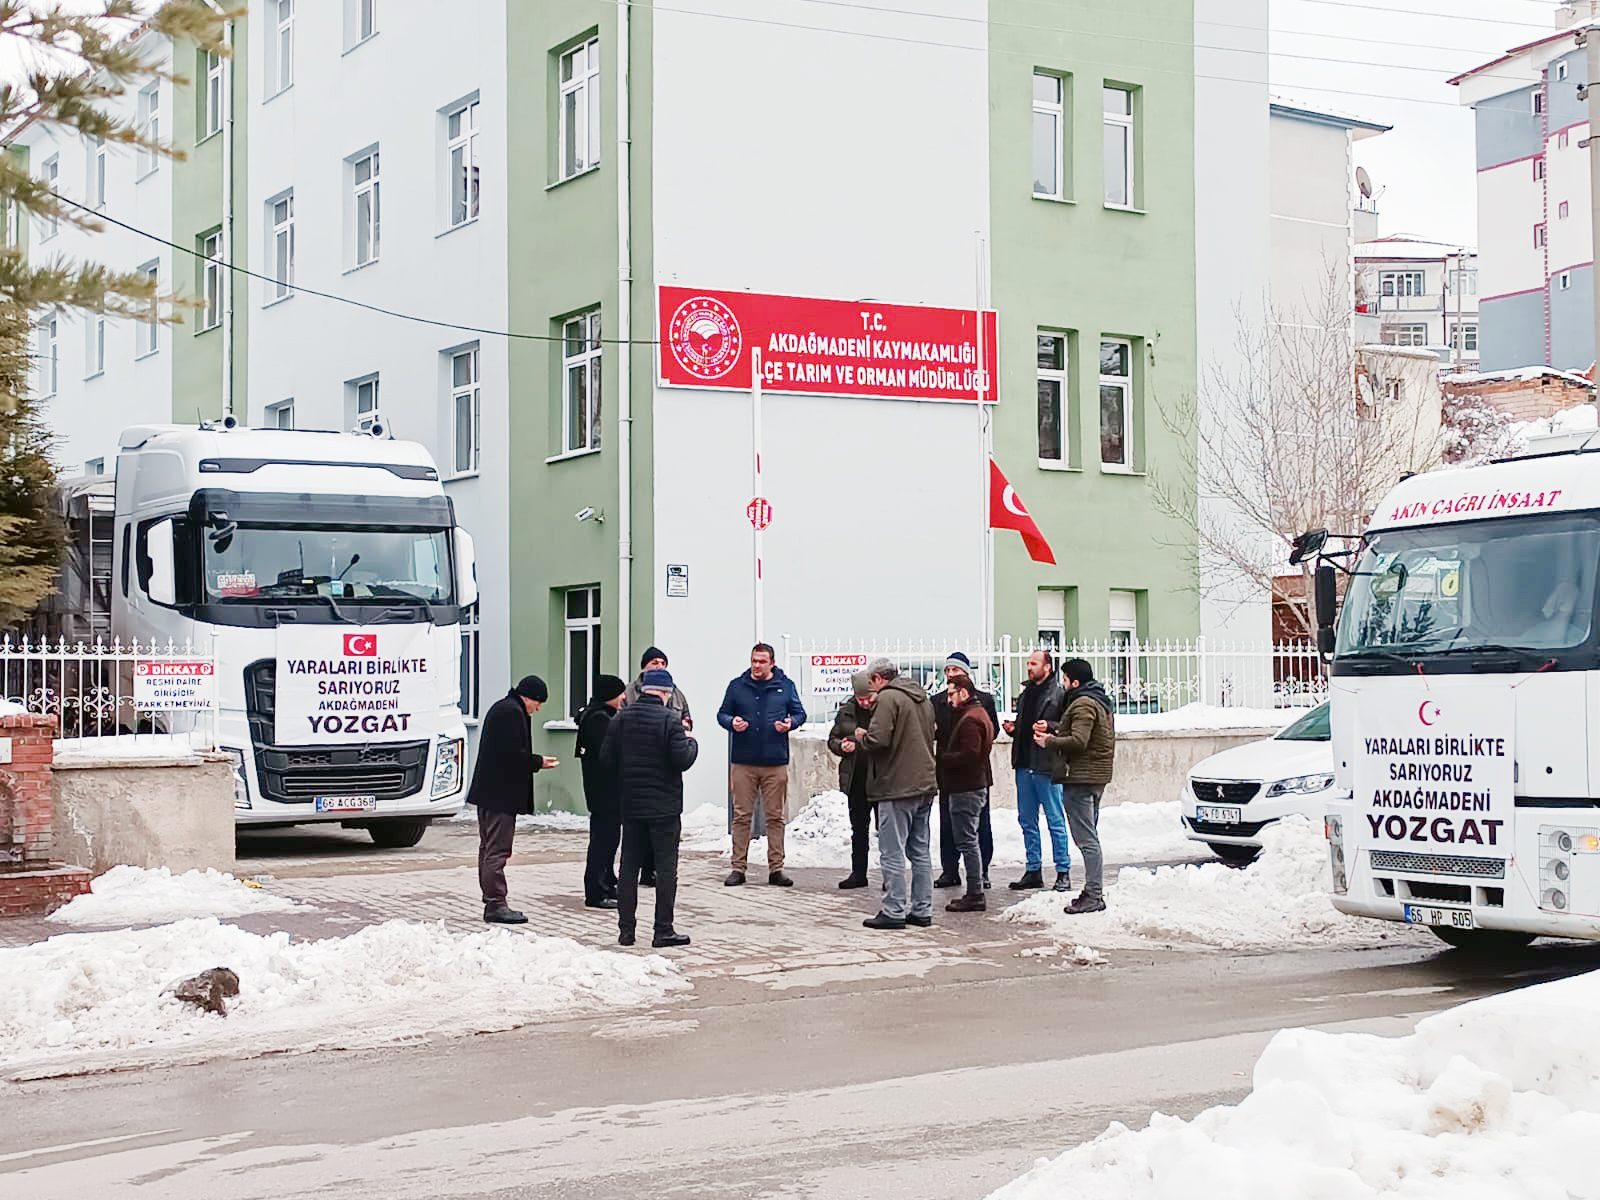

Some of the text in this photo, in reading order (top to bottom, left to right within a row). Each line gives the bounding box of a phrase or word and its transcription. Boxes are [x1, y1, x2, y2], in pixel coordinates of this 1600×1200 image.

[860, 311, 887, 331] T.C.
[768, 332, 976, 364] AKDAĞMADENİ KAYMAKAMLIĞI
[786, 362, 832, 384] TARIM
[835, 365, 854, 384] VE
[857, 366, 906, 388] ORMAN
[1390, 489, 1562, 521] AKIN ÇAĞRI İNŞAAT
[152, 663, 198, 675] DİKKAT
[287, 656, 428, 675] YARALARI BİRLİKTE
[824, 655, 857, 665] DİKKAT
[318, 679, 401, 695] SARIYORUZ
[318, 697, 399, 711] AKDAĞMADENİ
[307, 713, 412, 734] YOZGAT
[1364, 733, 1505, 757] YARALARI BİRLİKTE
[1389, 763, 1473, 783] SARIYORUZ
[1372, 787, 1491, 812] AKDAĞMADENİ
[1366, 813, 1504, 846] YOZGAT
[1452, 911, 1471, 927] 605
